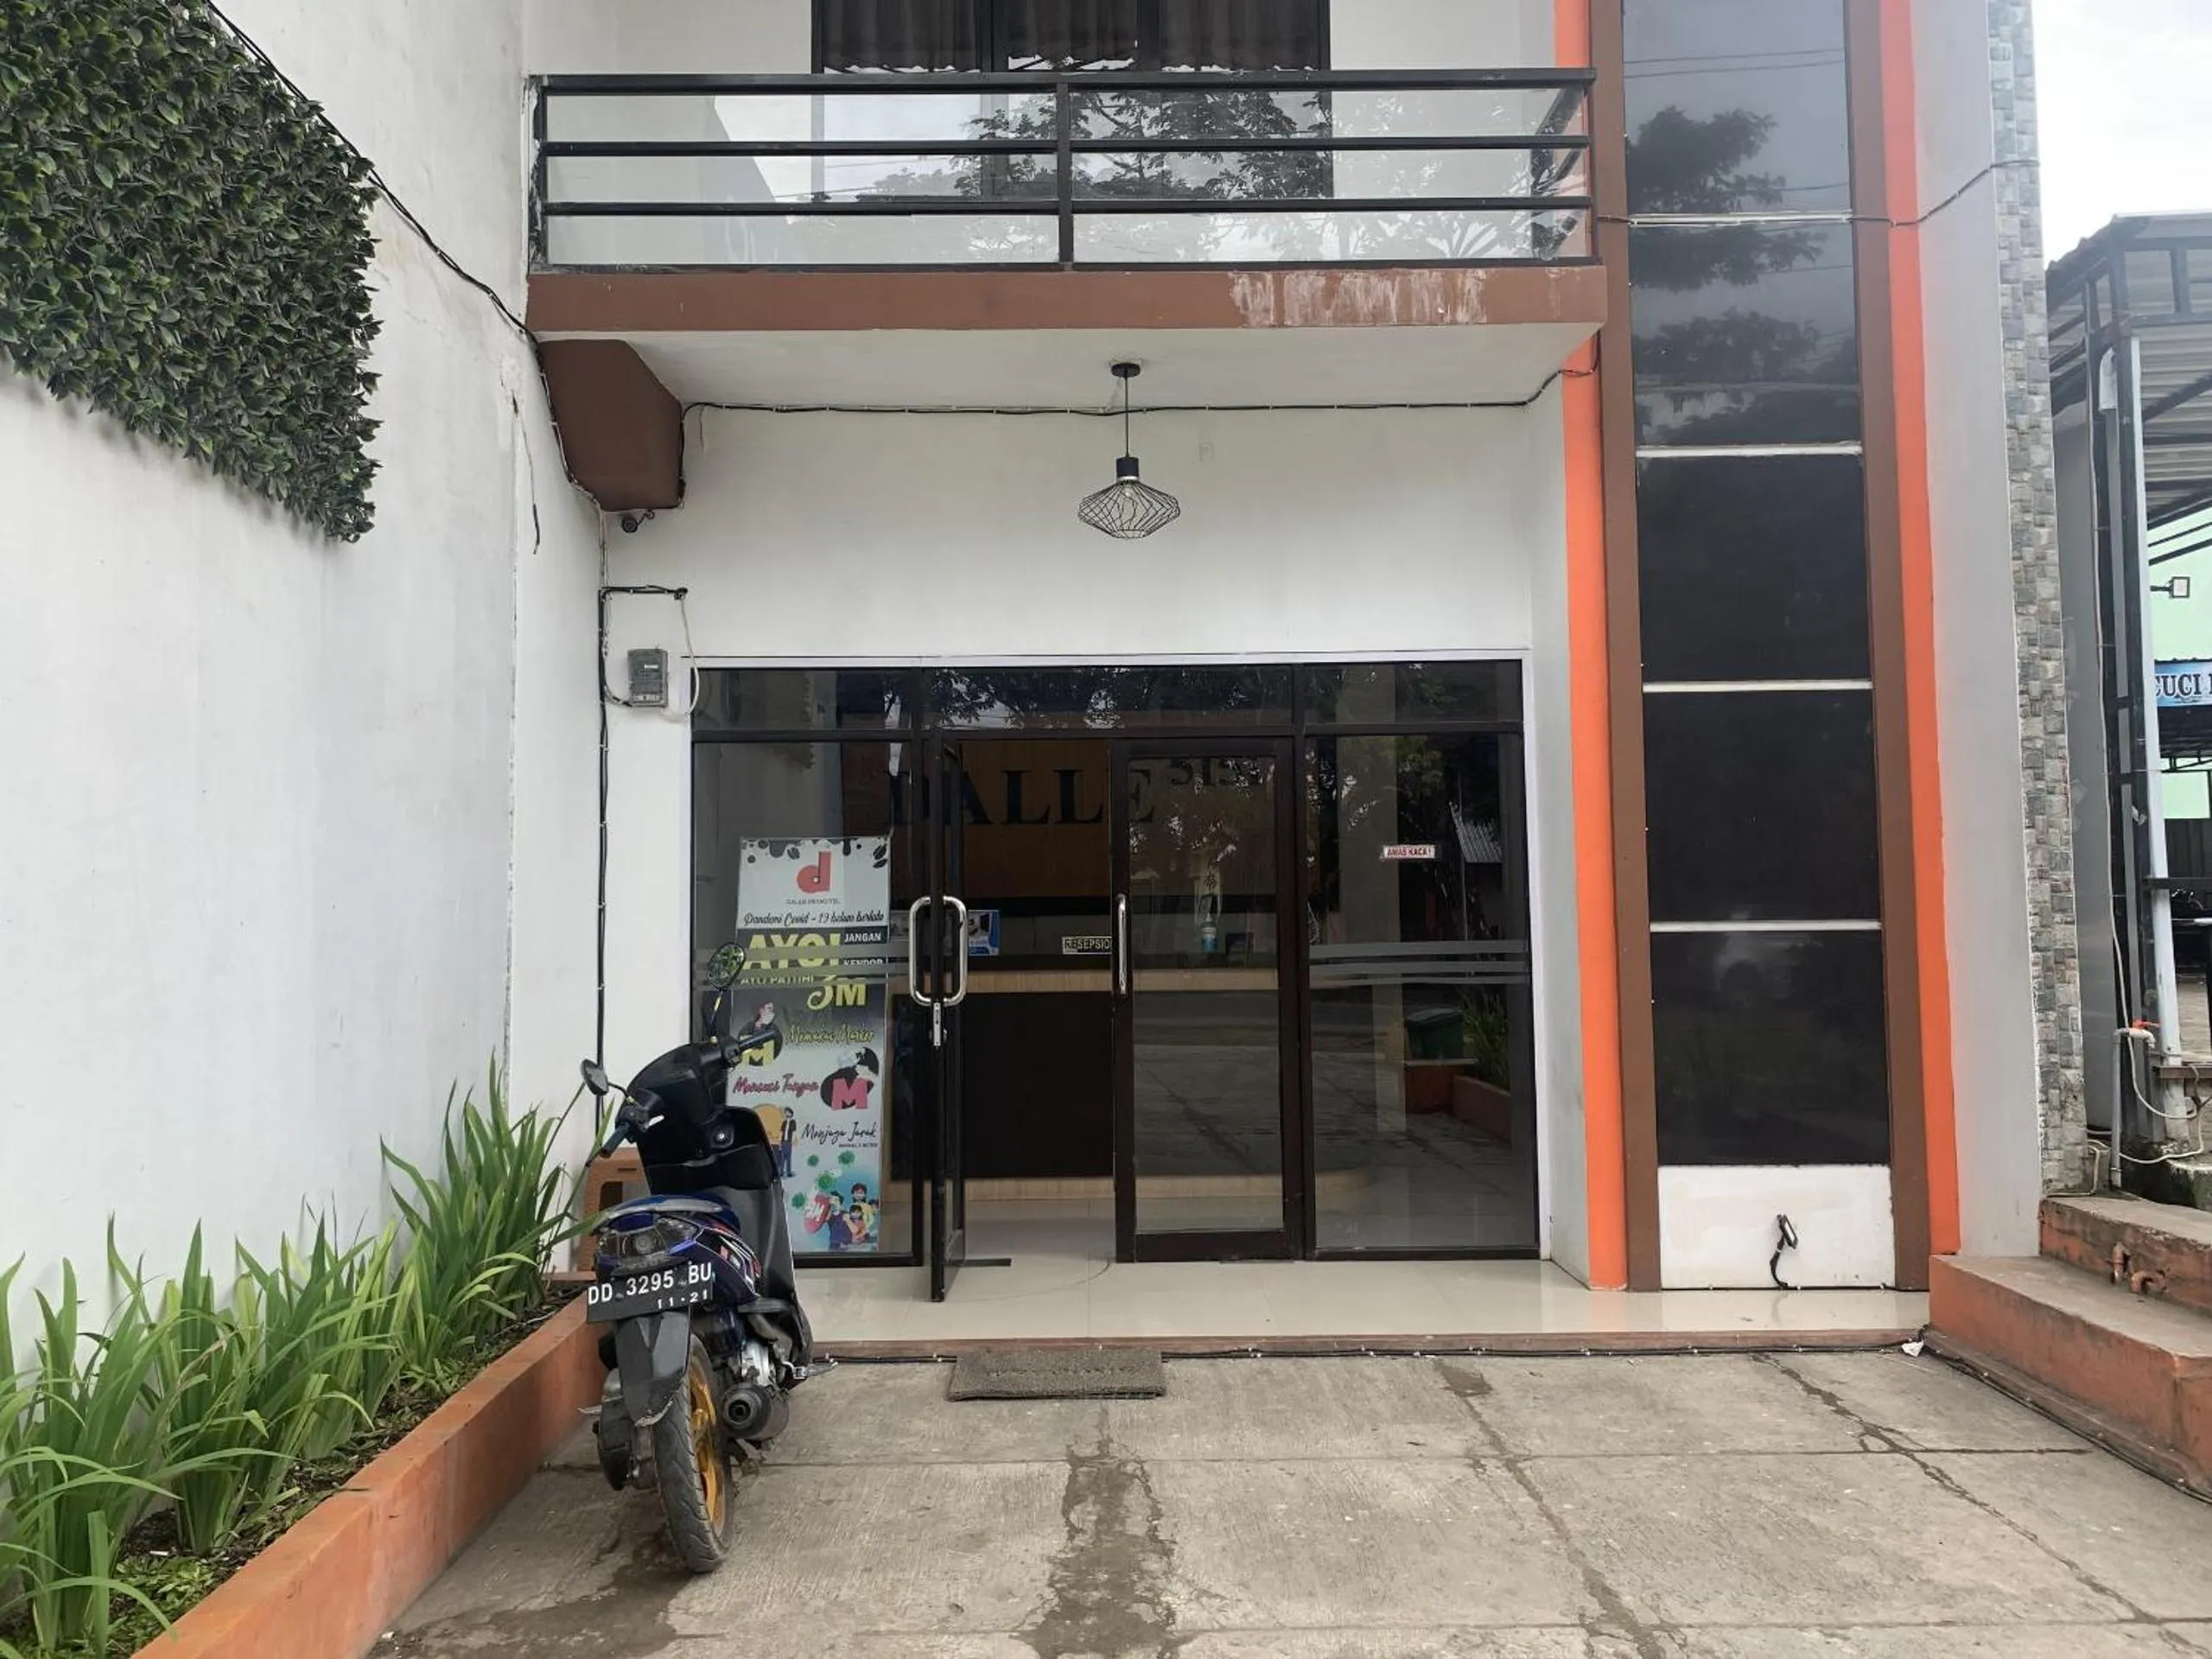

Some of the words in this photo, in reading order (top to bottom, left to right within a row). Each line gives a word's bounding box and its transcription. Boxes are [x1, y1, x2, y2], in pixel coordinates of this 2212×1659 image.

[843, 932, 881, 943] JANGAN
[1065, 938, 1110, 950] RESEPSIO
[588, 1283, 613, 1306] DD
[626, 1270, 674, 1296] 3295
[688, 1262, 712, 1284] BU
